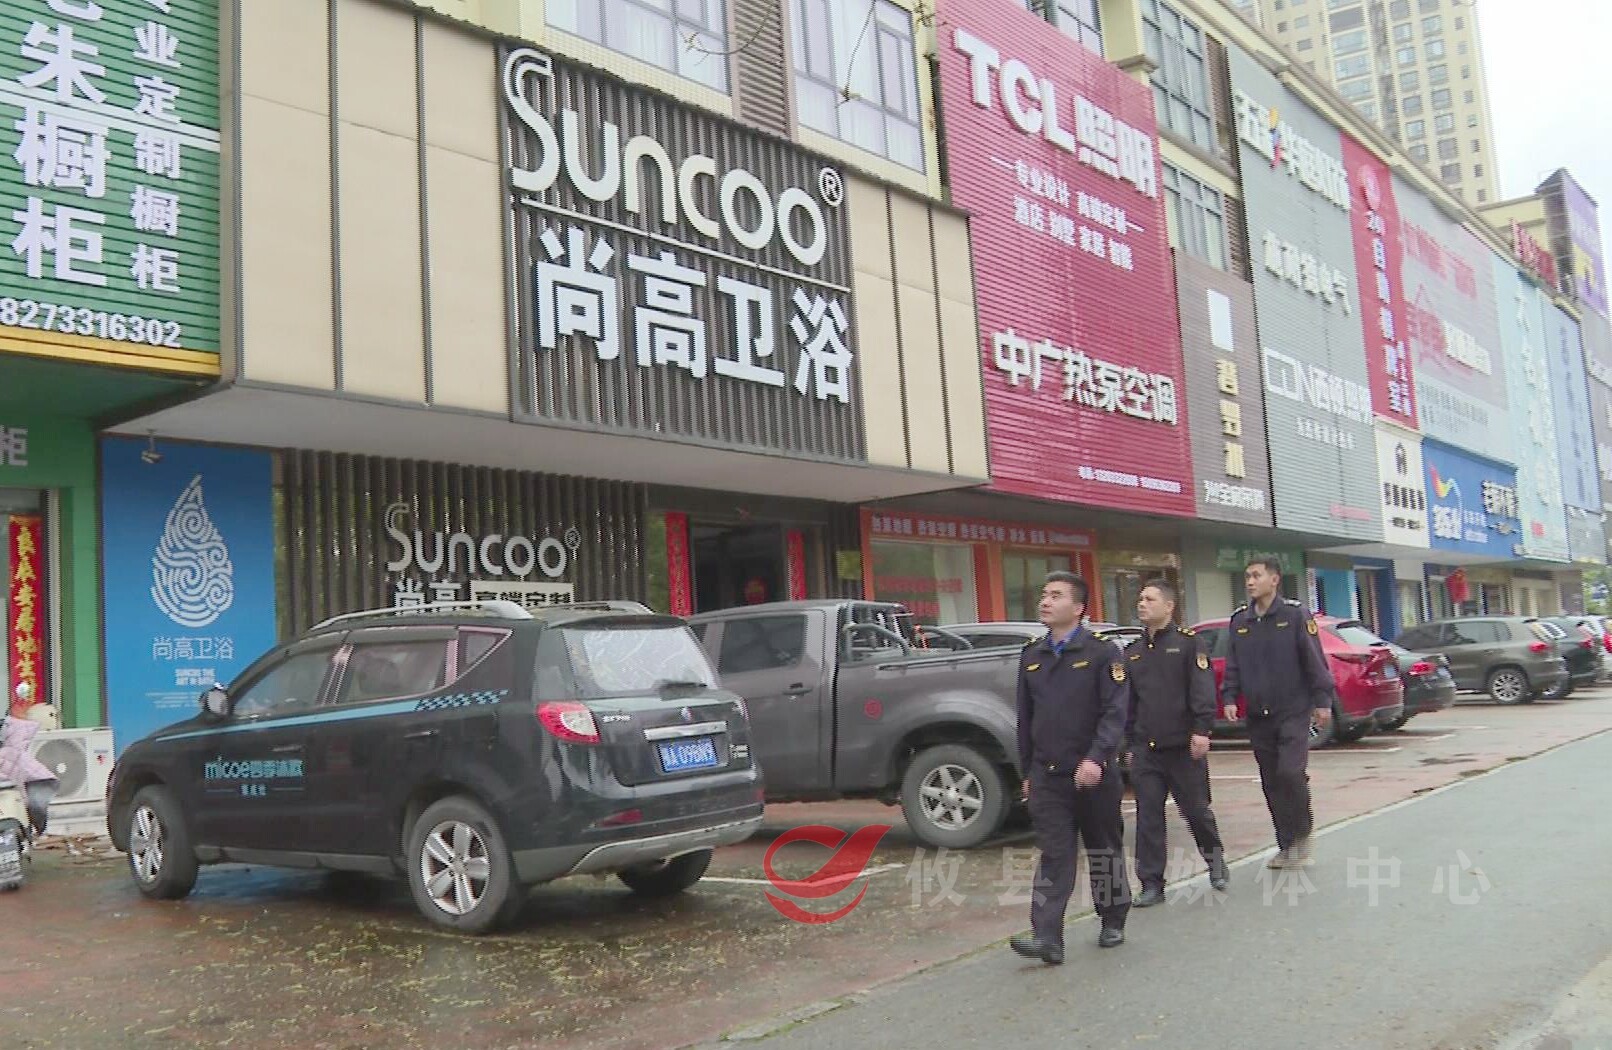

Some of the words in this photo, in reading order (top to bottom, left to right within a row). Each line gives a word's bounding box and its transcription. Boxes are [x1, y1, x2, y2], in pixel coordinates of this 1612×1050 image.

[130, 0, 182, 294] 业定制橱柜
[0, 297, 182, 348] 8273316302
[535, 226, 853, 404] 尚高卫浴
[992, 327, 1178, 426] 中广热泵空调
[152, 636, 235, 661] 尚高卫浴
